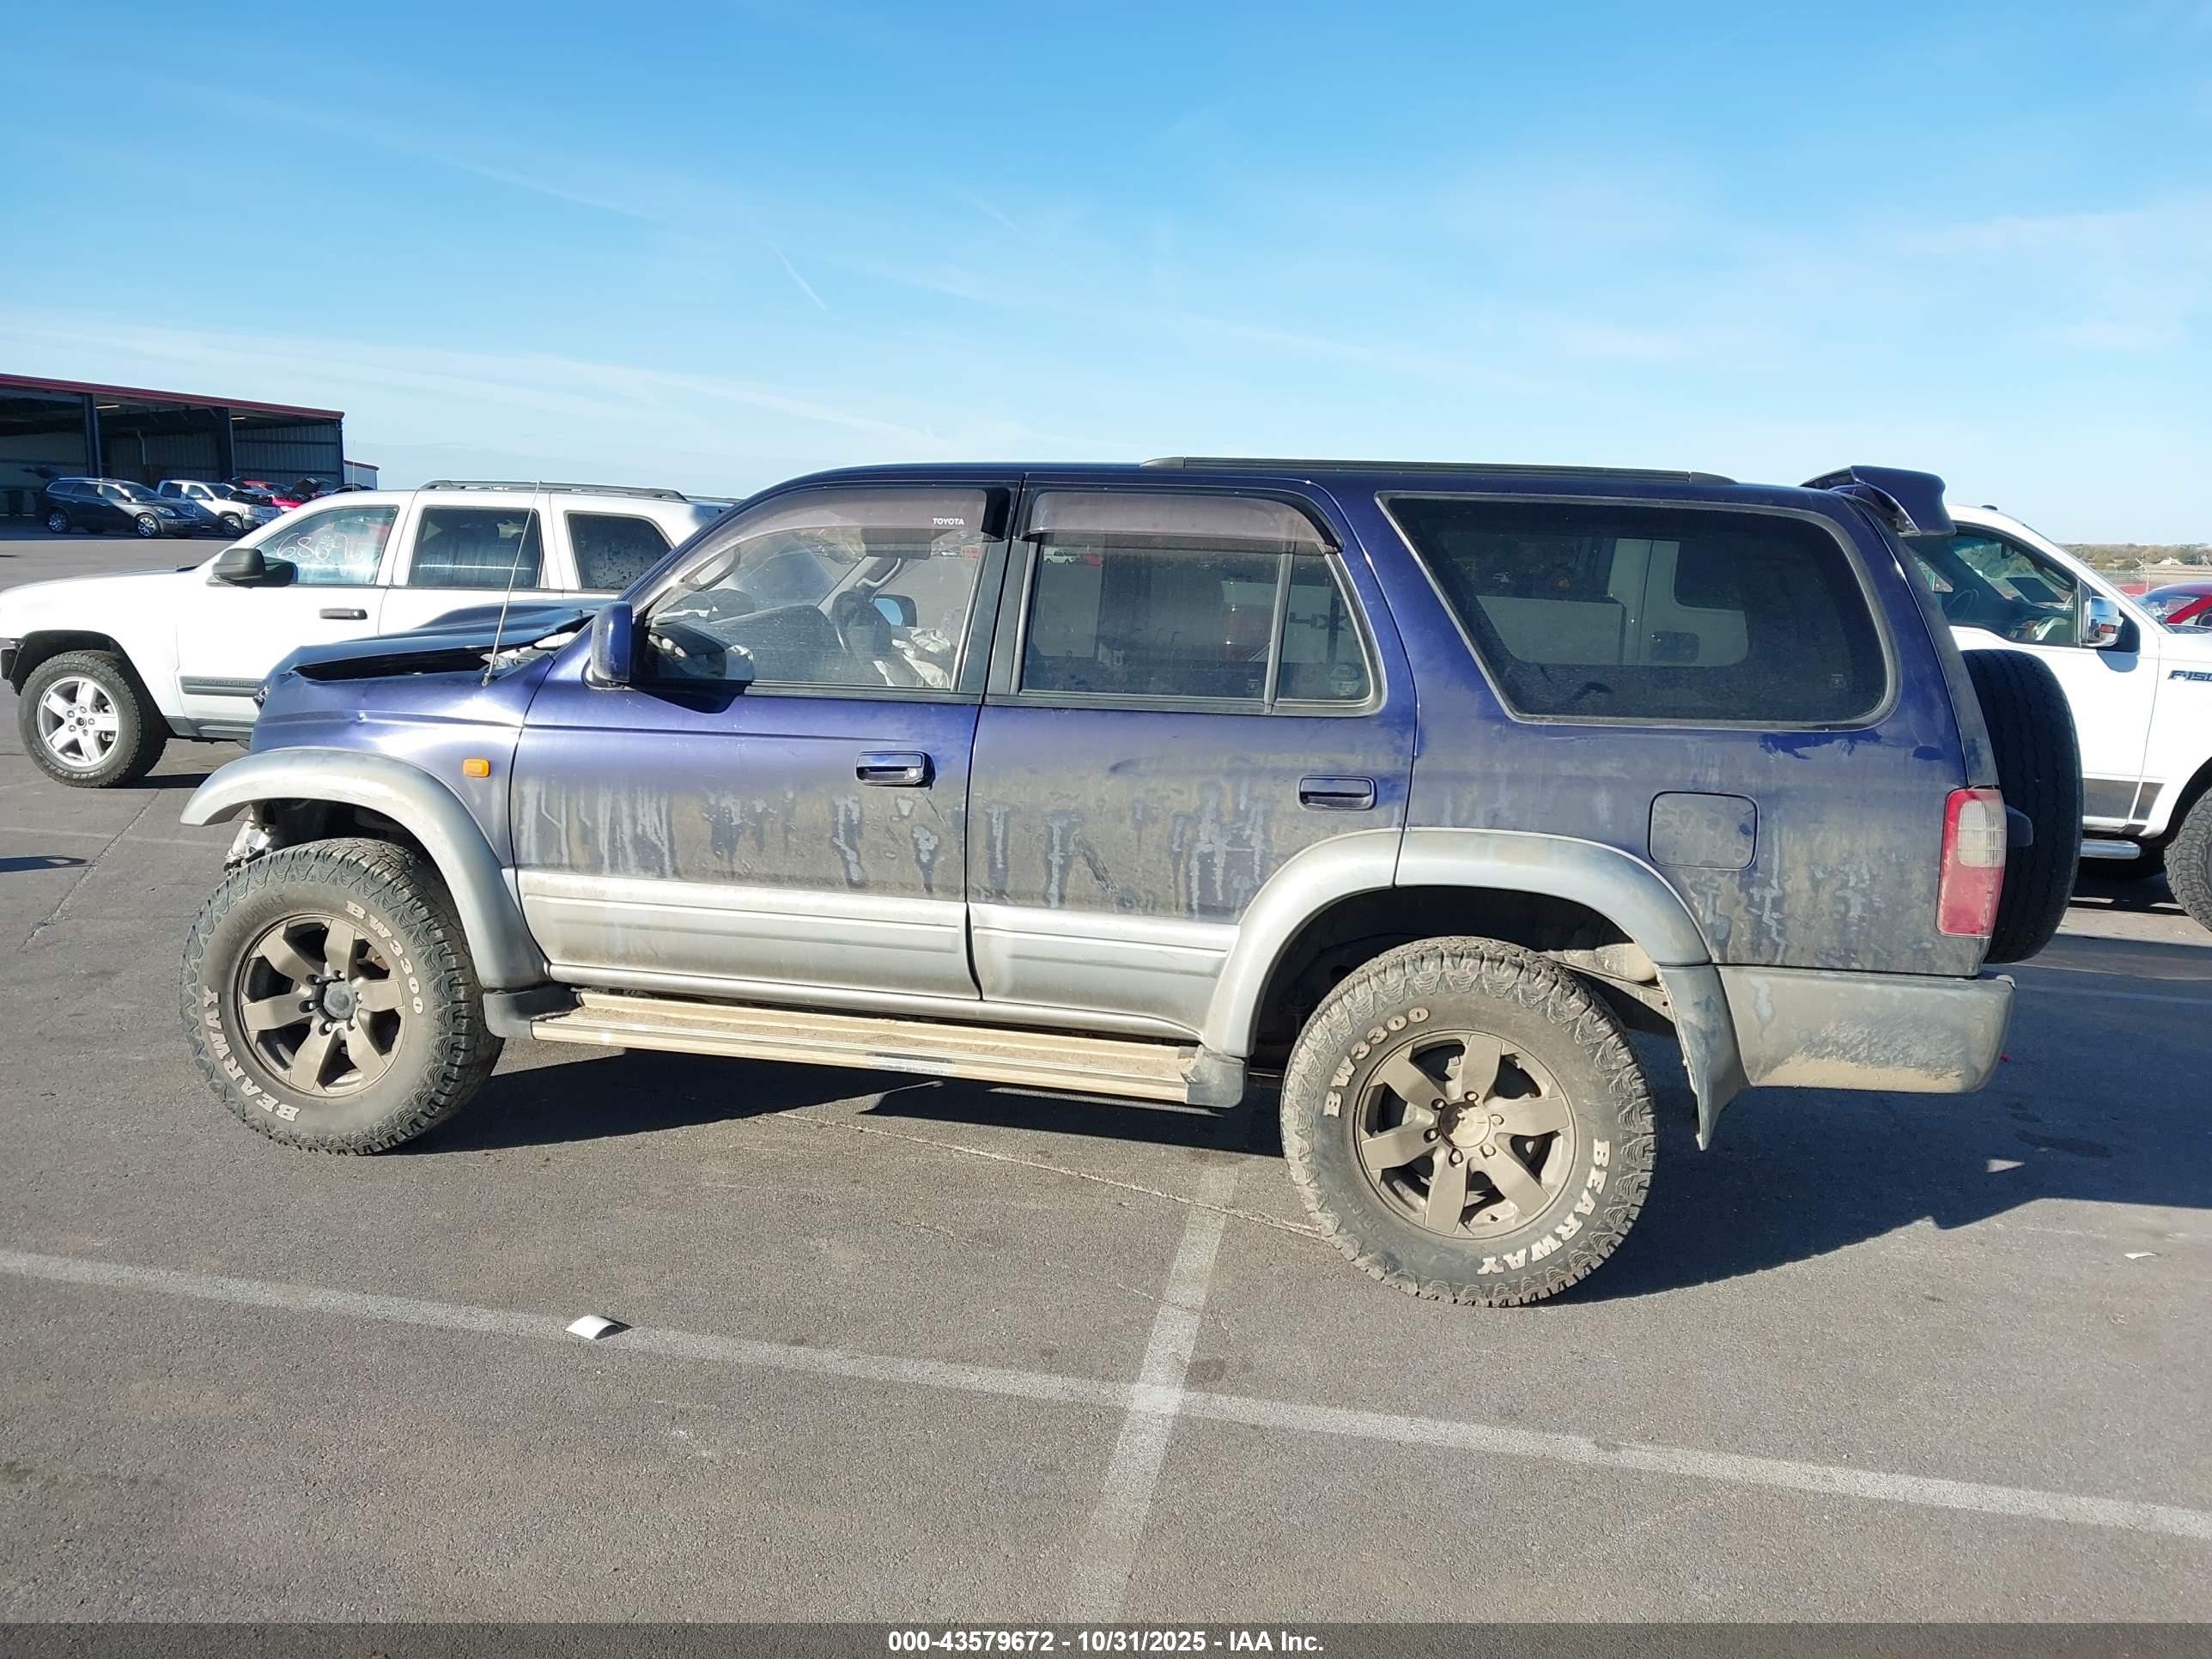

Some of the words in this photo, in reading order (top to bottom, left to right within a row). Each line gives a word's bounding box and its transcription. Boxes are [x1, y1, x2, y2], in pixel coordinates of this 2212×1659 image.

[933, 517, 964, 526] TOYOTA
[345, 899, 424, 1014] BW3300
[203, 985, 301, 1122] BEARWAY
[1476, 1138, 1611, 1275] BEARWAY
